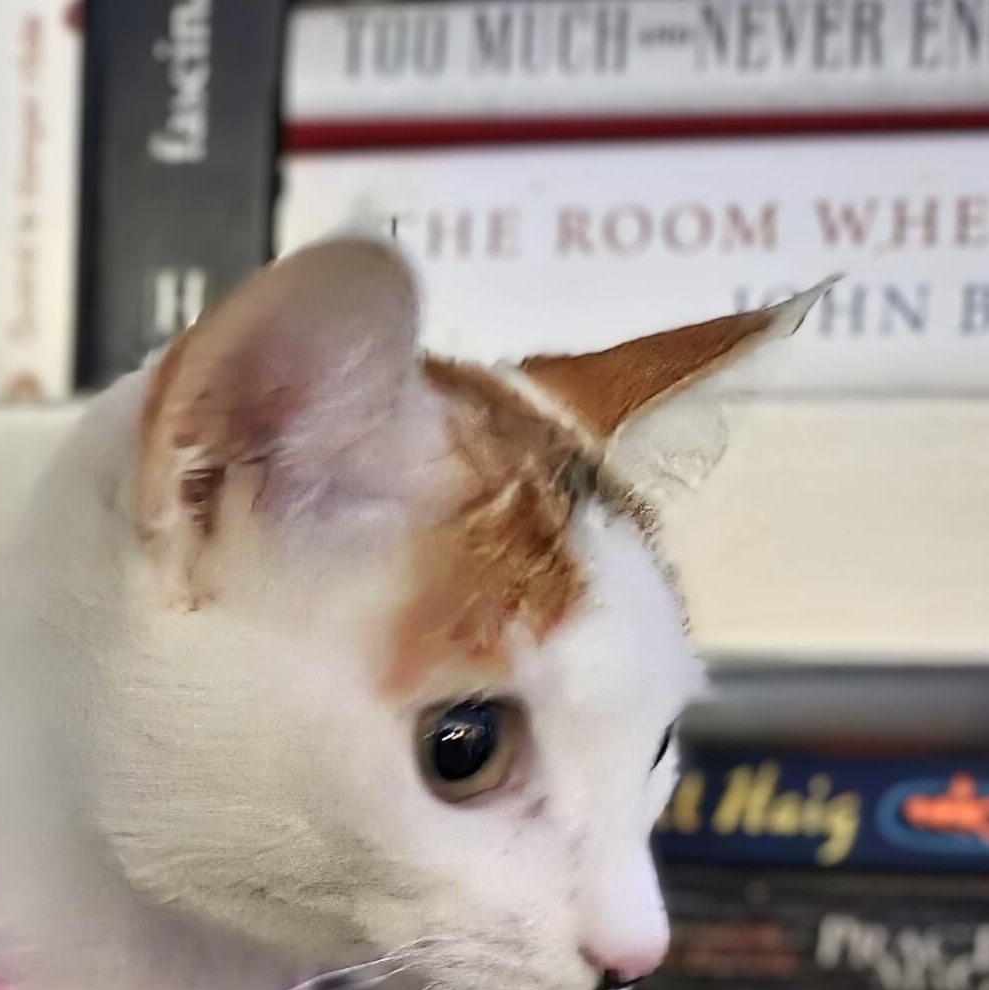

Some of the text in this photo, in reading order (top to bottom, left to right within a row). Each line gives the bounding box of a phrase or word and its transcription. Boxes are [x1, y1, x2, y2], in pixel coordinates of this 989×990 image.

[343, 5, 449, 78] TOO
[469, 0, 627, 76] MUCH
[694, 0, 882, 72] NEVER
[555, 200, 780, 256] ROOM
[817, 192, 989, 253] WHE
[711, 761, 860, 866] Haig
